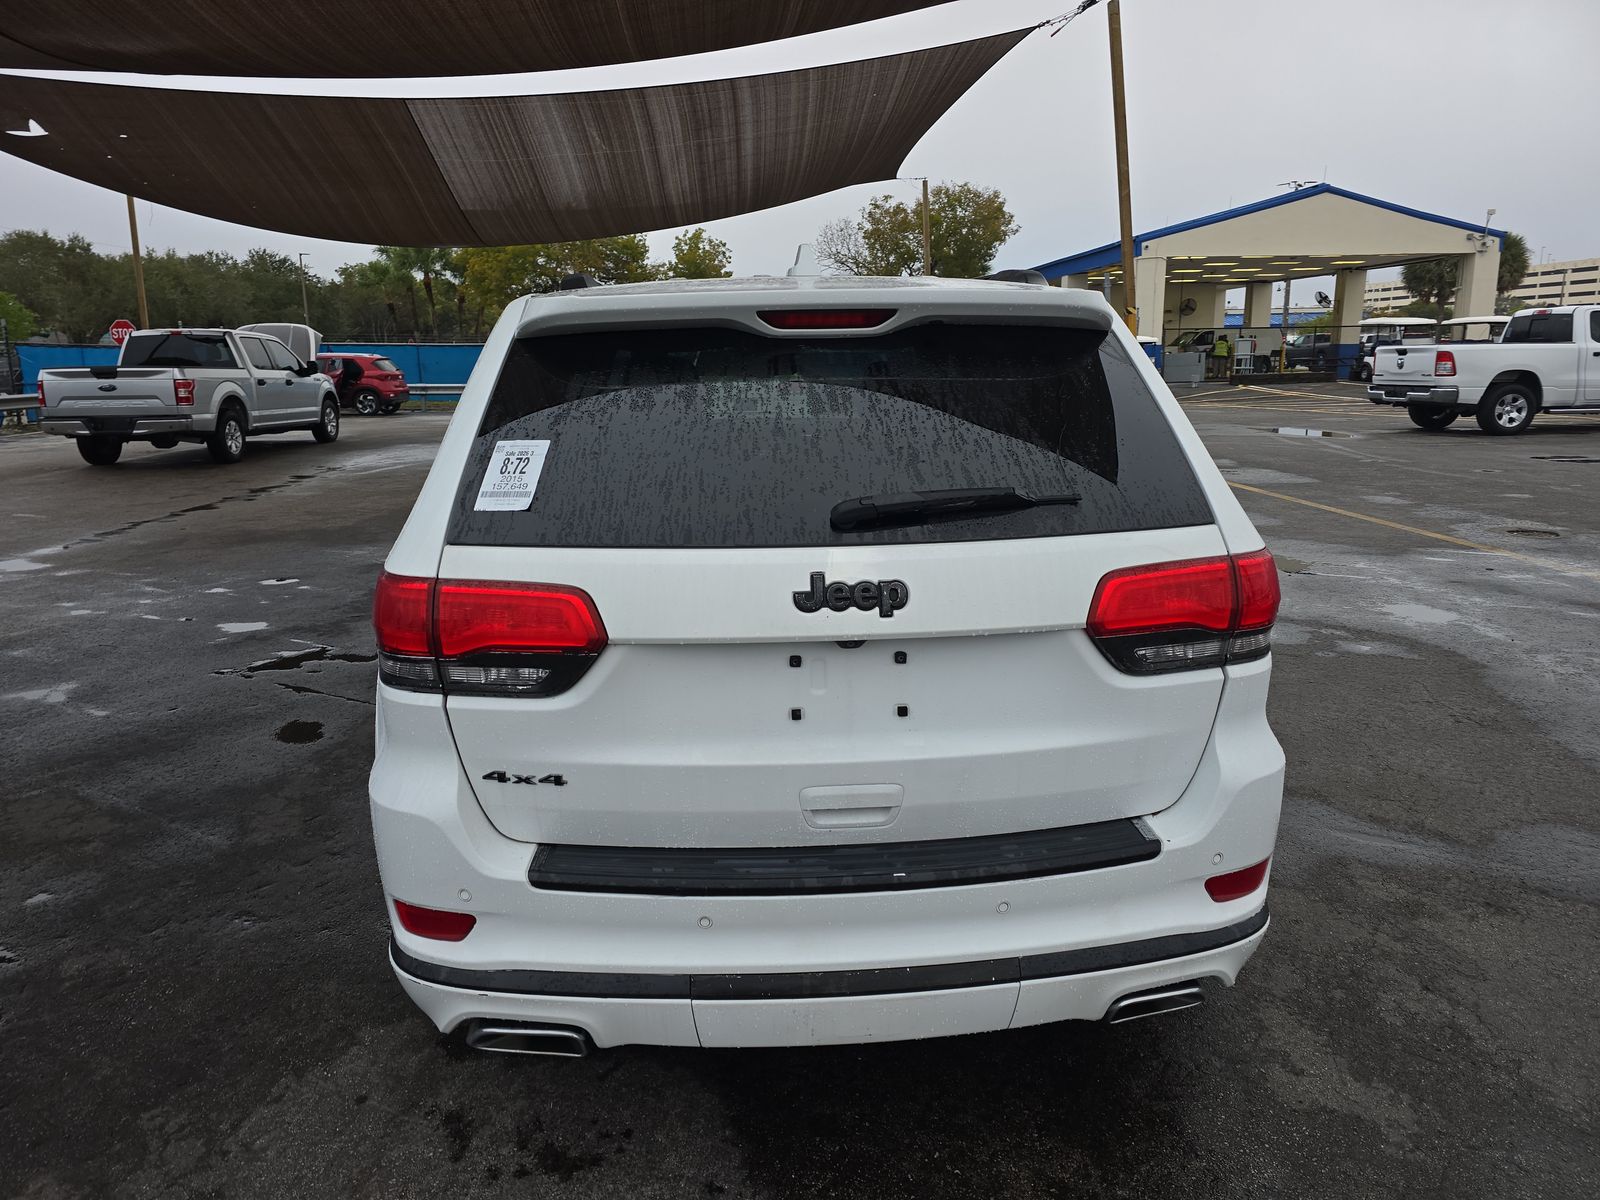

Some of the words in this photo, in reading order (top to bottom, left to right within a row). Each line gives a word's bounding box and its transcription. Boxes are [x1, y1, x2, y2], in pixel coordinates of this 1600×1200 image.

[500, 457, 530, 474] 8:72
[793, 571, 909, 618] Jeep
[481, 770, 568, 786] 4x4
